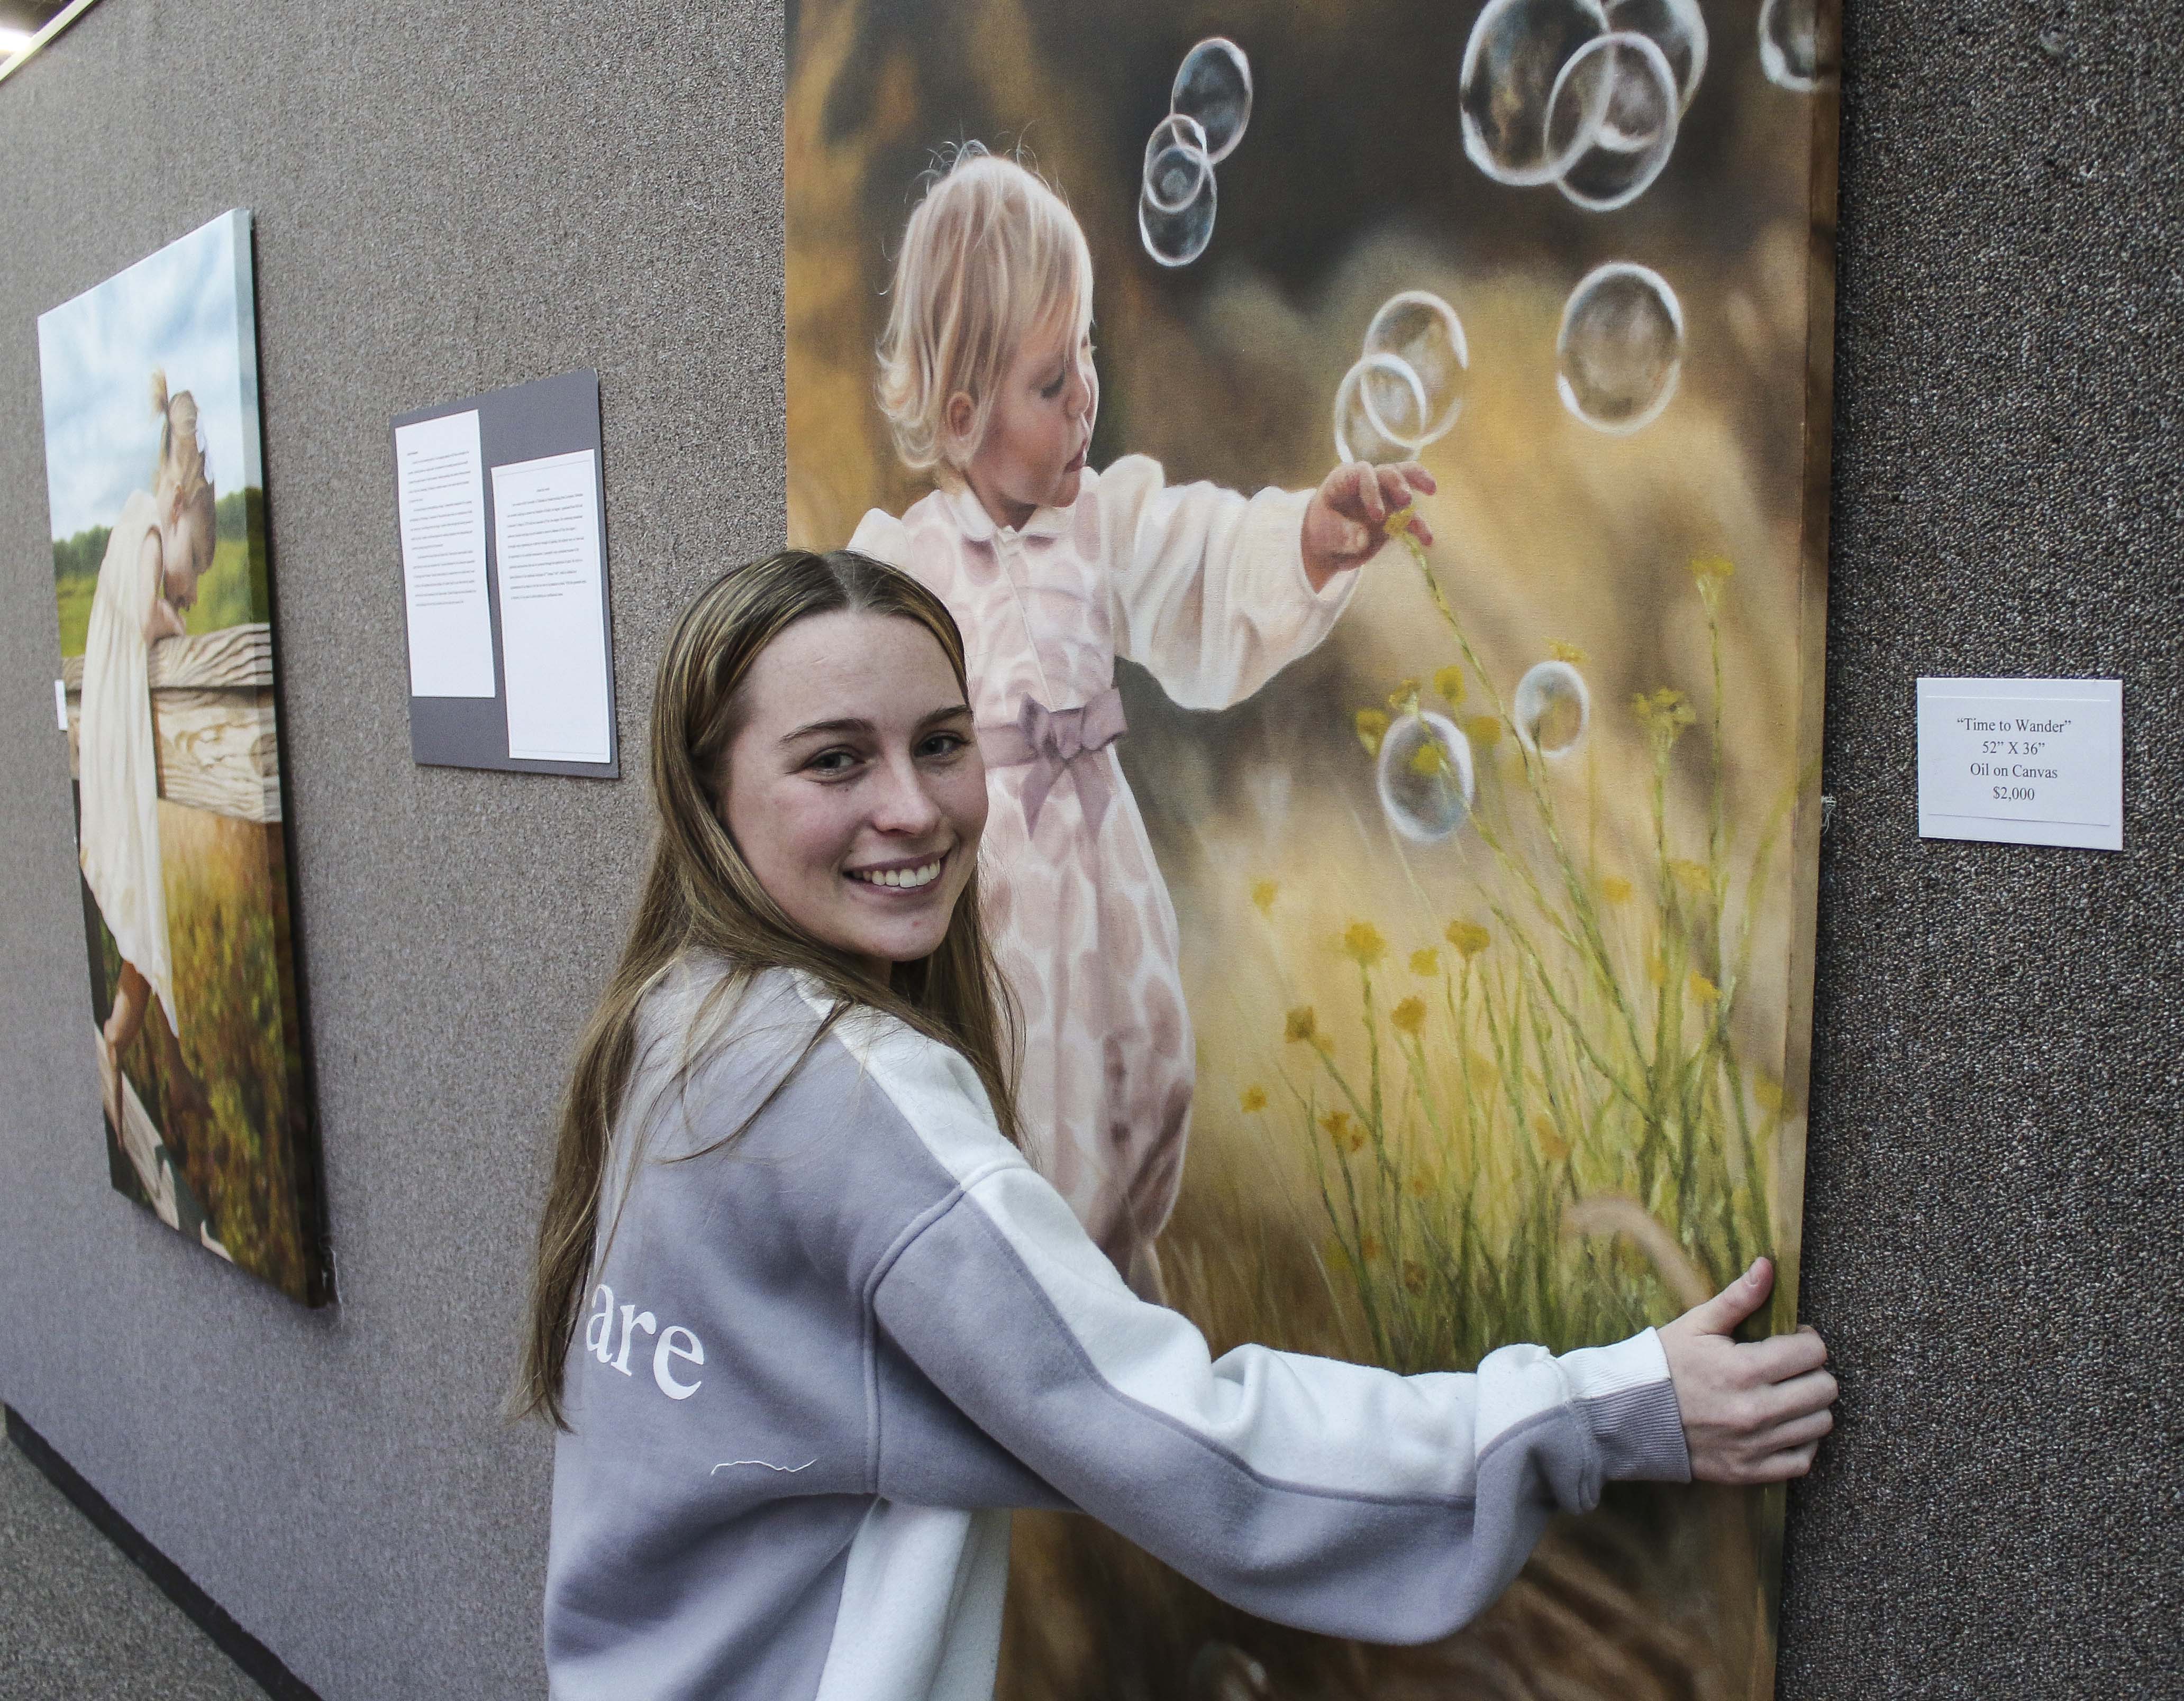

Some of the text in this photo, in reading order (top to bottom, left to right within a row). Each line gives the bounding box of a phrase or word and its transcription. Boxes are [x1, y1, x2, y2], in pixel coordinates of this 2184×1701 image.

[1957, 718, 2071, 733] “Time to Wander”
[1982, 741, 2045, 755] 52” X 36”
[1970, 763, 2058, 778] Oil on Canvas
[1992, 787, 2035, 801] $2,000
